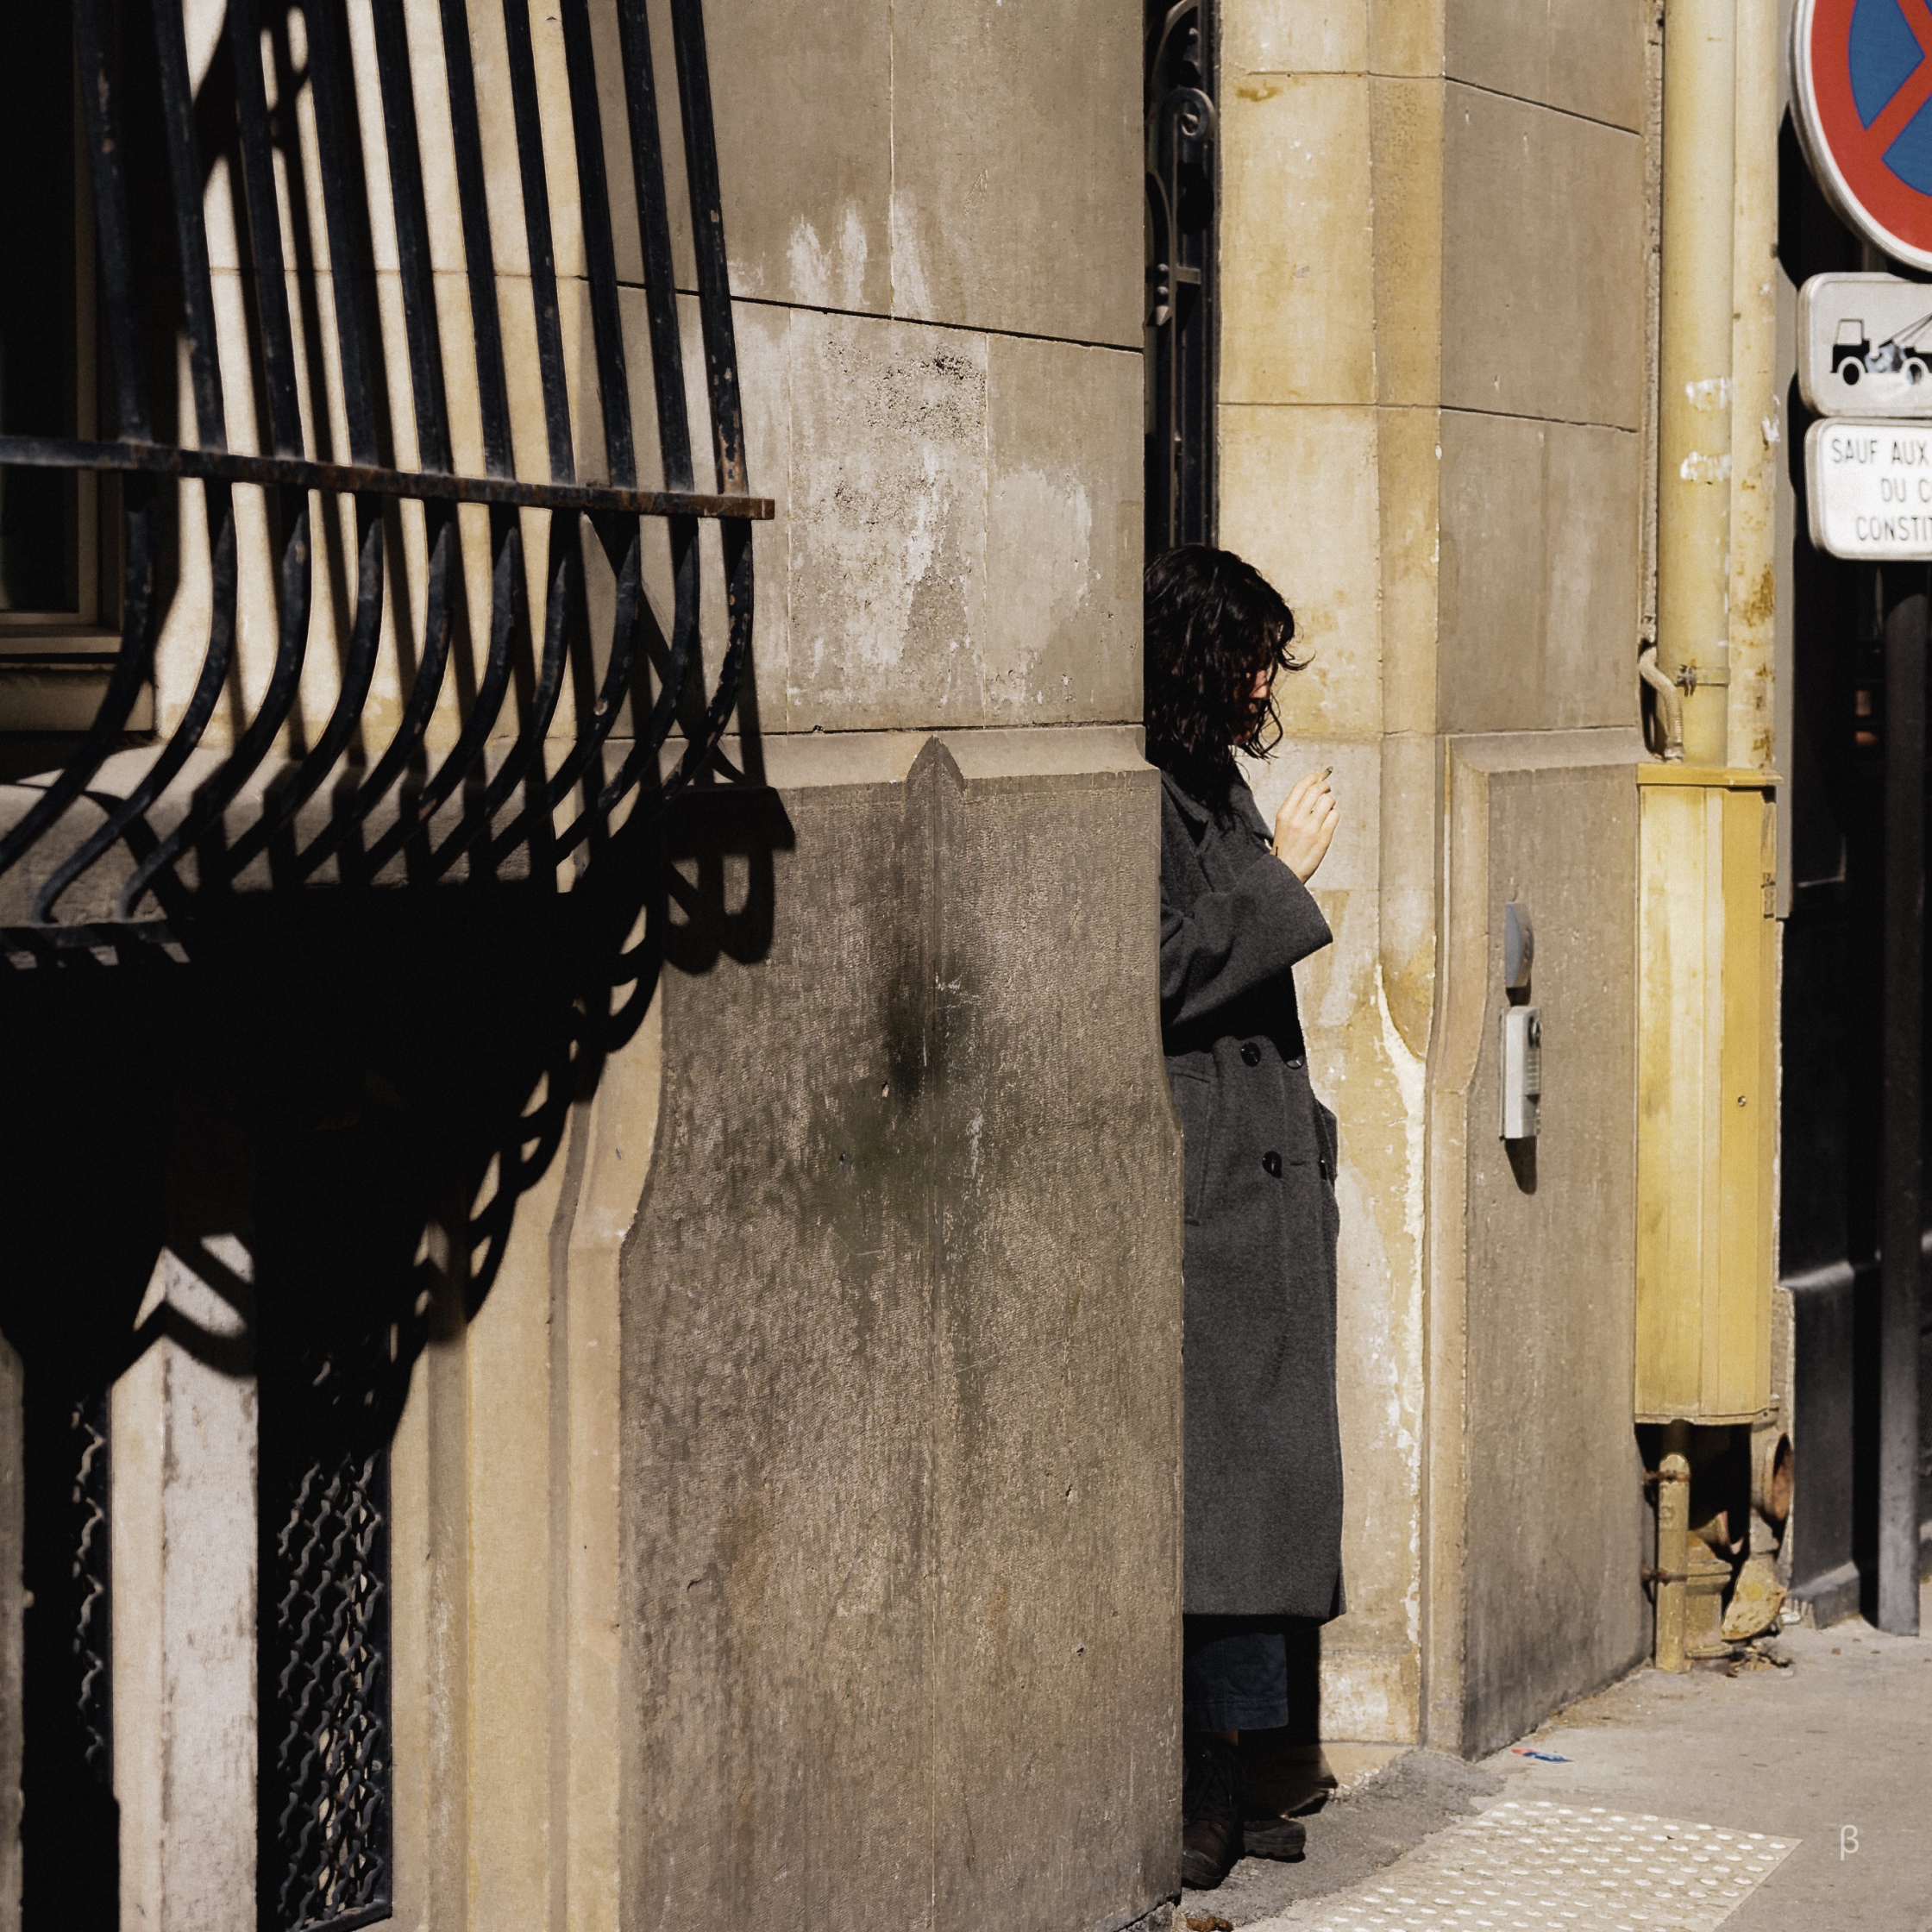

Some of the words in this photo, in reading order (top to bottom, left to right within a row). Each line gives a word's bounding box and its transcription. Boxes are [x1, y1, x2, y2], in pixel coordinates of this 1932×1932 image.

[1831, 438, 1878, 463] SAUF
[1891, 439, 1930, 465] AUX
[1881, 477, 1907, 502] DU
[1919, 479, 1932, 503] C
